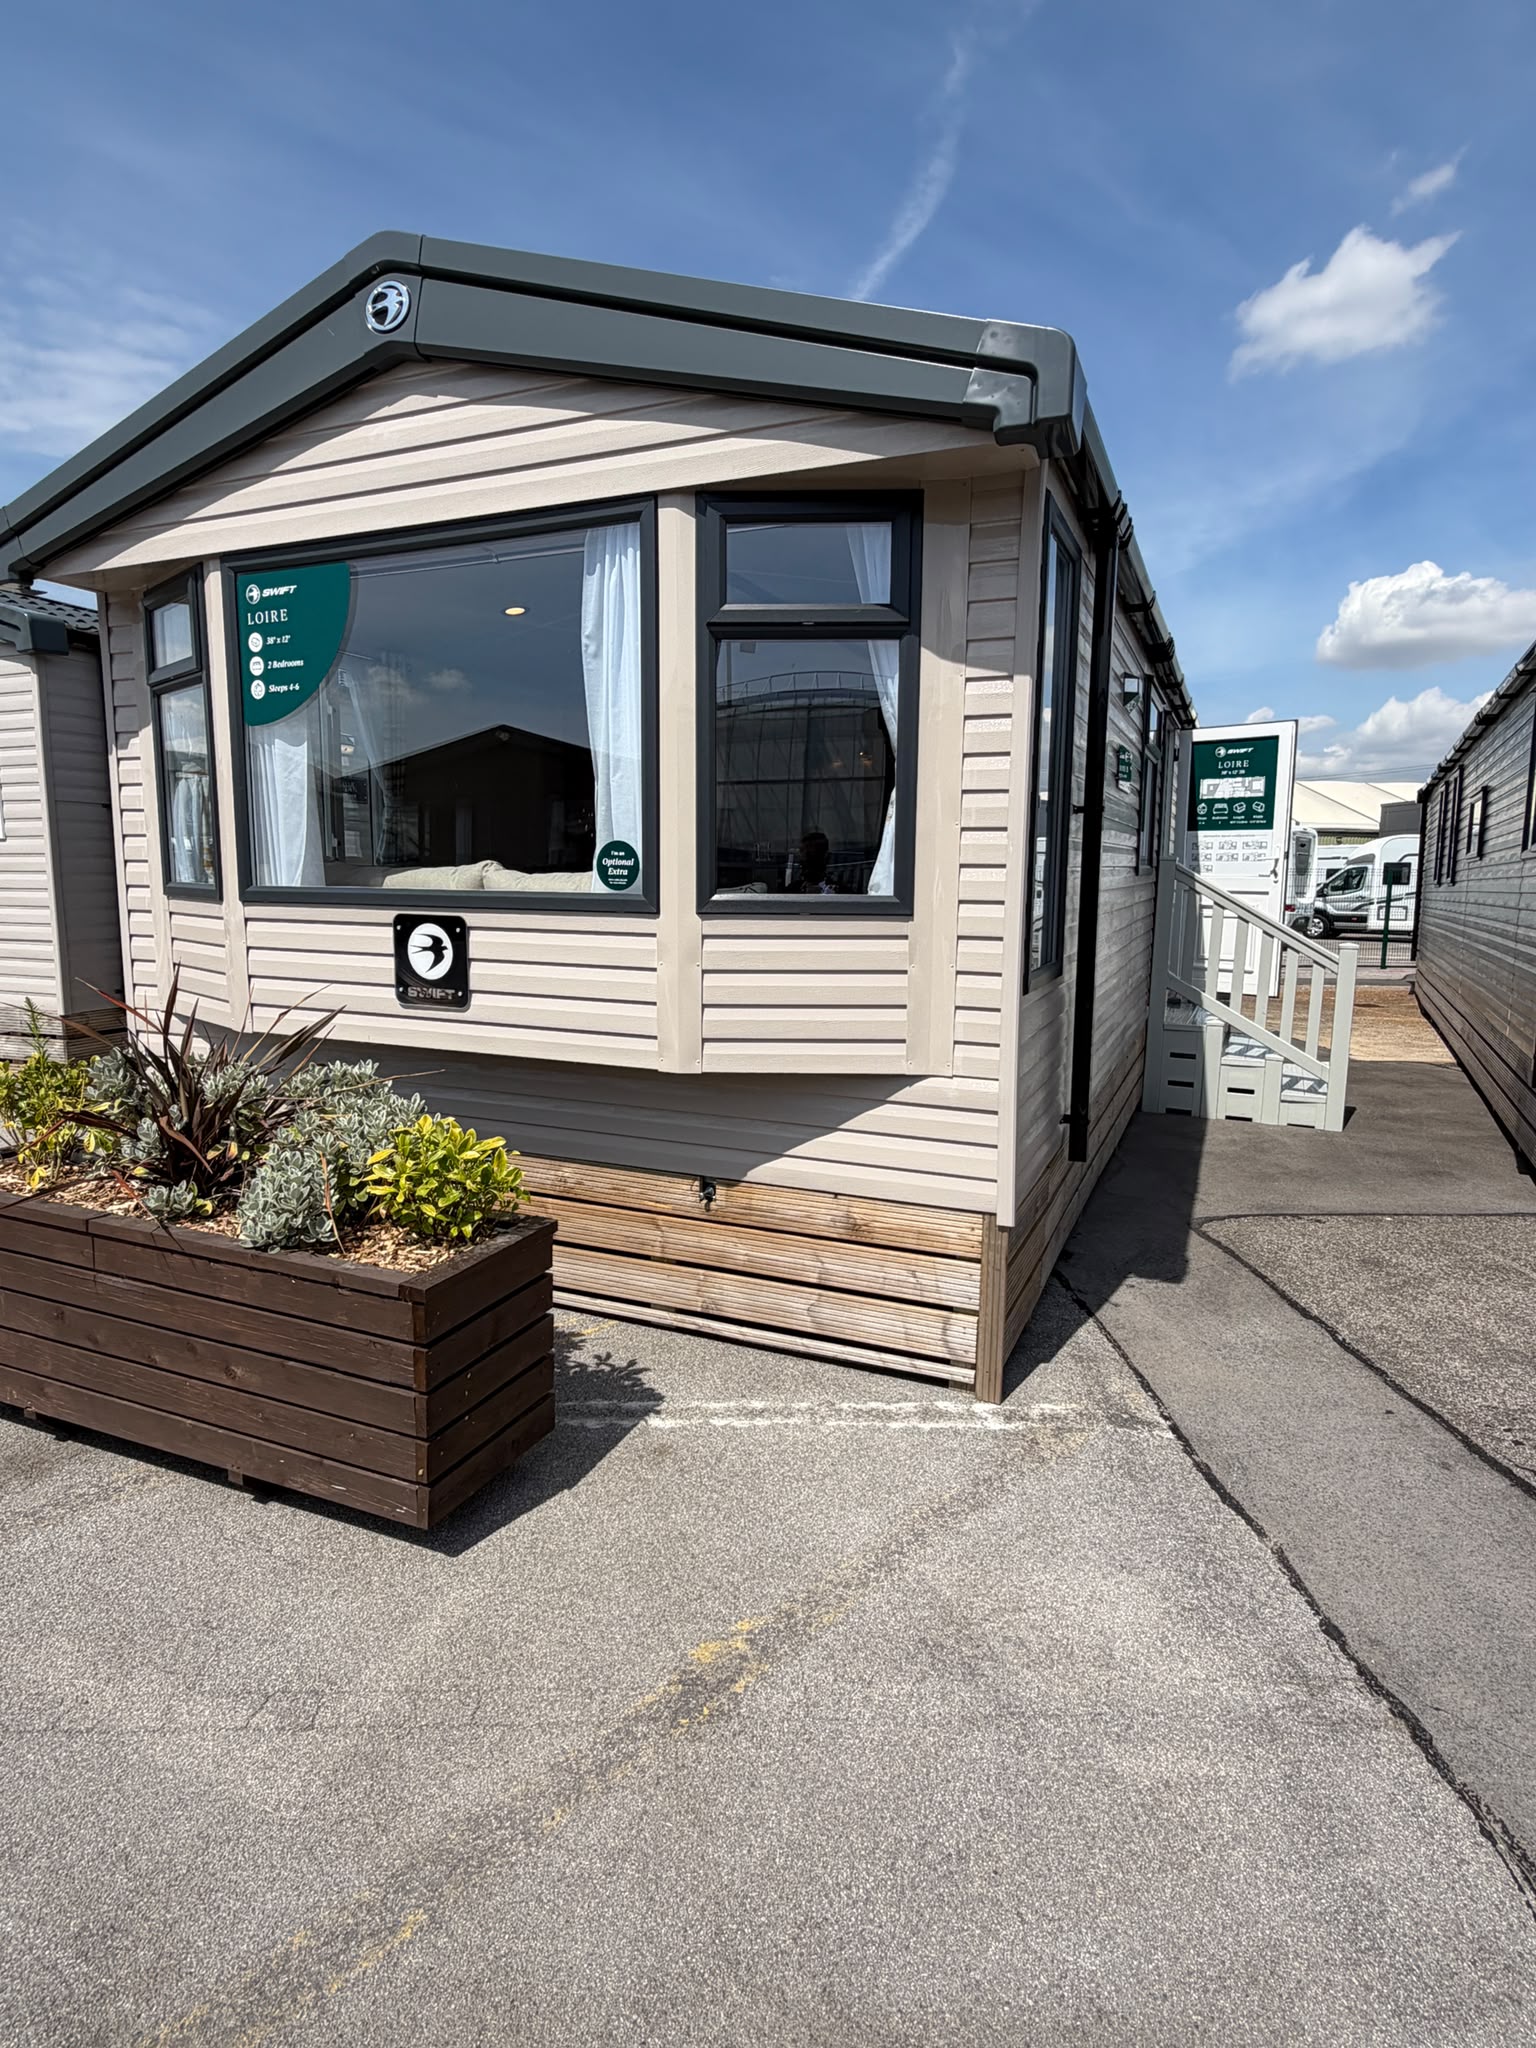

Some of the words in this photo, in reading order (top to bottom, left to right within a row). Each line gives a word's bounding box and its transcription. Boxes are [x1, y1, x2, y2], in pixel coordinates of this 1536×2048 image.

[262, 585, 297, 597] SWIFT
[247, 609, 288, 625] LOIRE
[267, 661, 272, 669] 2
[272, 660, 304, 669] Bedrooms
[268, 684, 288, 693] Sleeps
[289, 683, 300, 691] 4-6
[1218, 759, 1250, 769] LOIRE
[602, 858, 634, 867] Optional
[608, 867, 628, 875] Extra
[407, 986, 456, 1000] SWIFT
